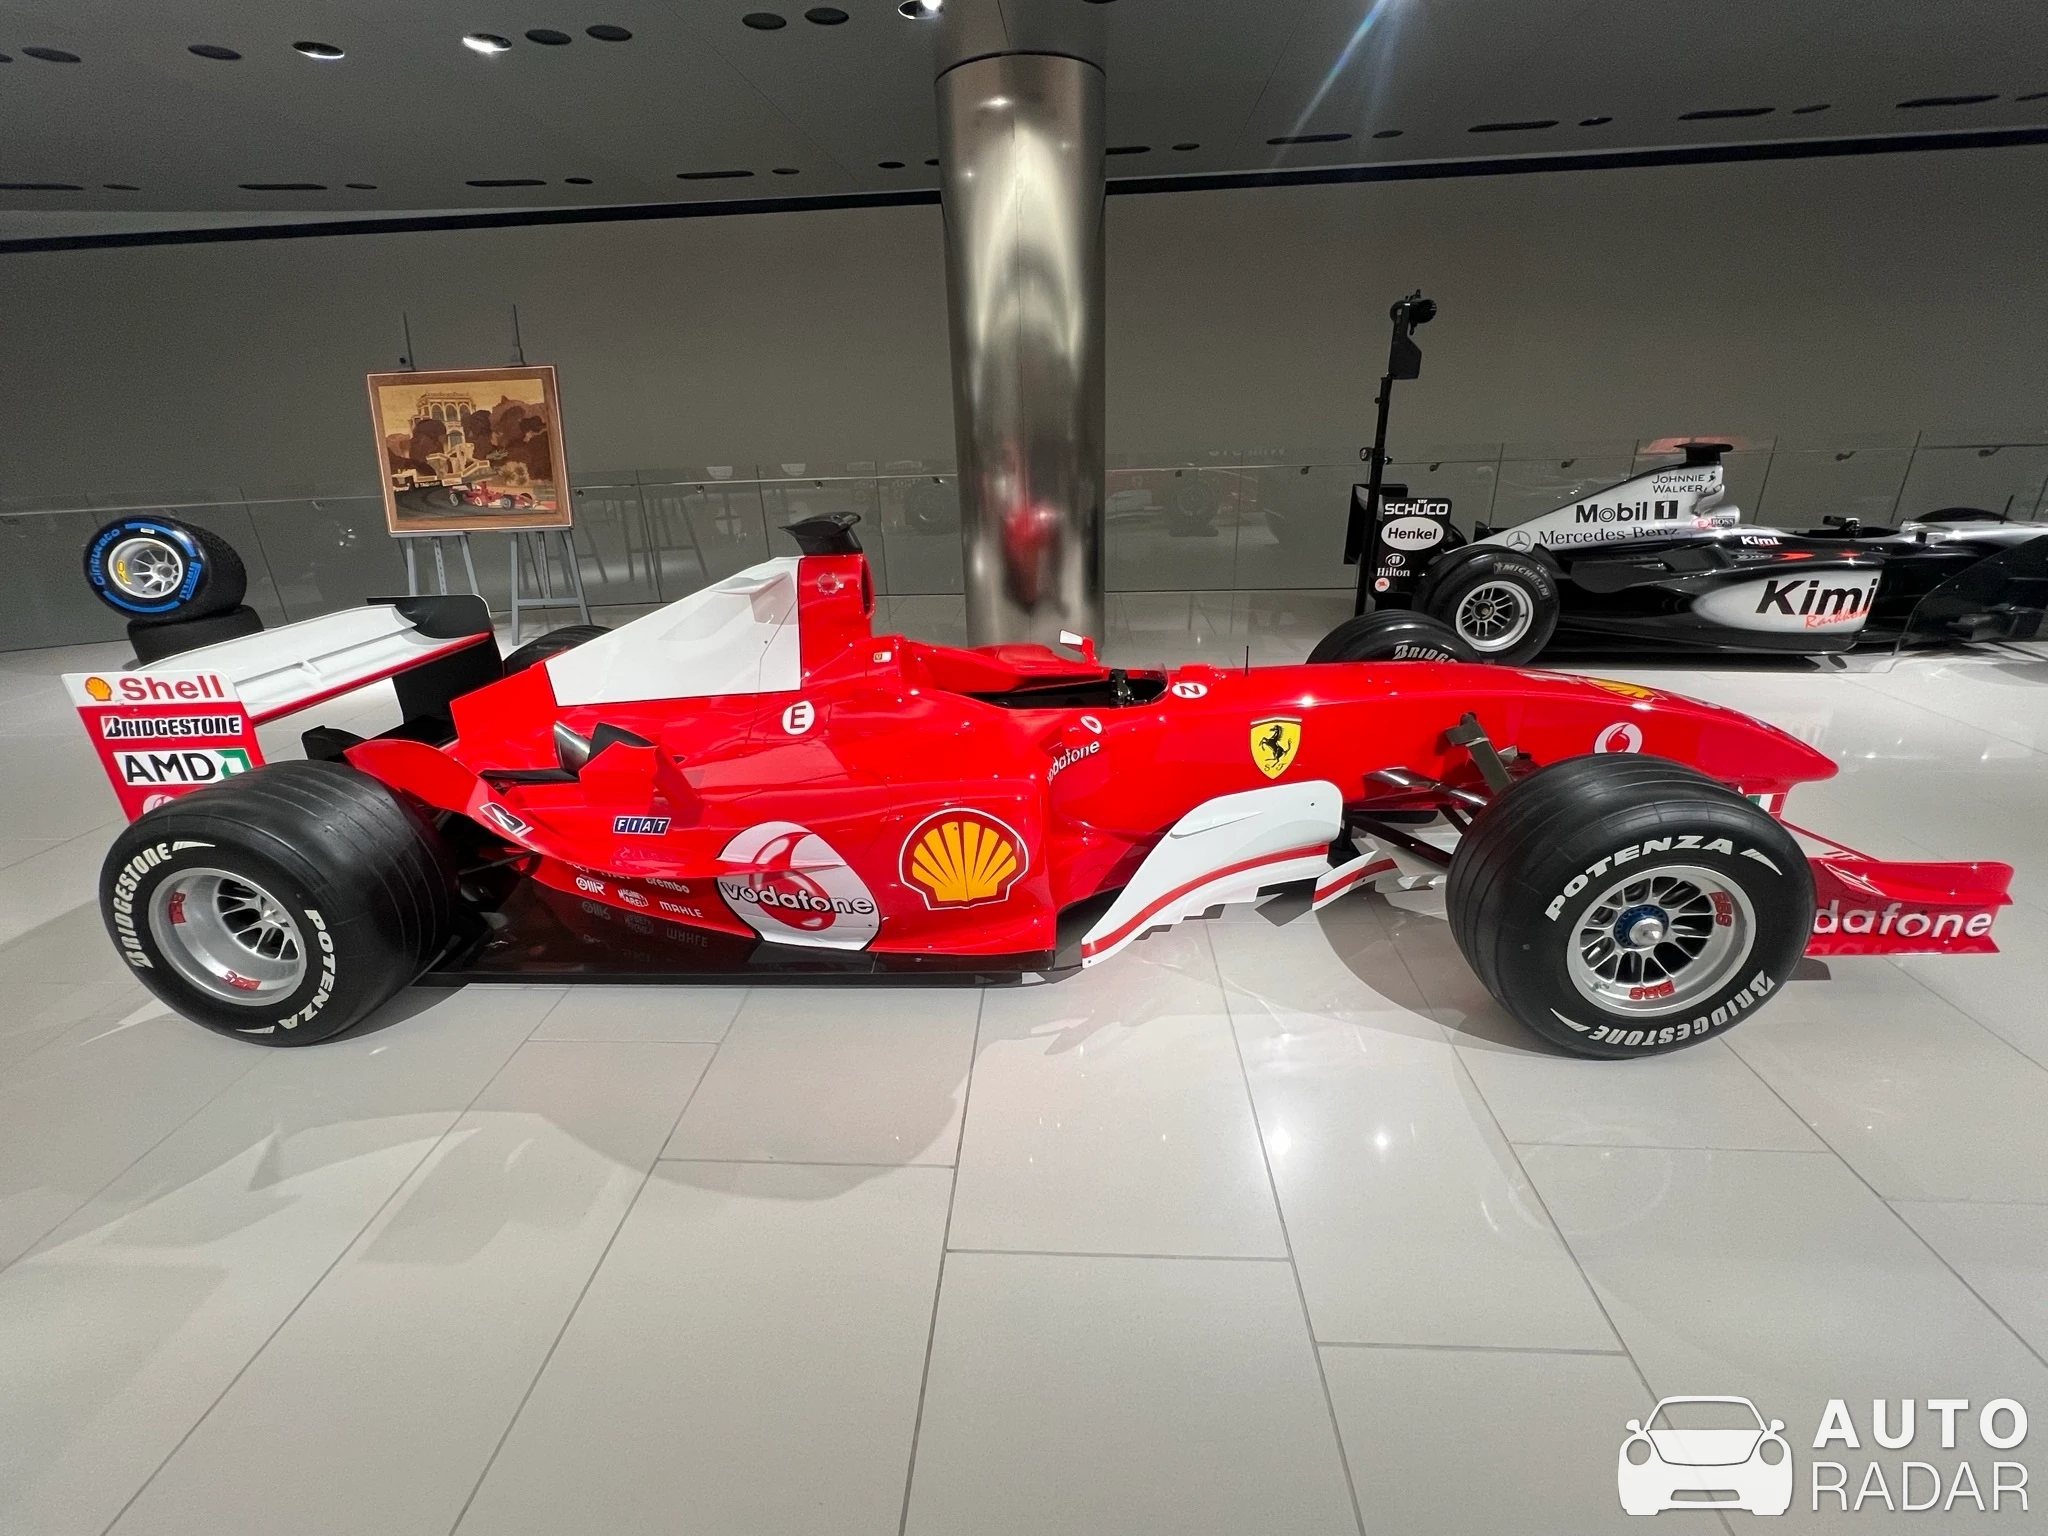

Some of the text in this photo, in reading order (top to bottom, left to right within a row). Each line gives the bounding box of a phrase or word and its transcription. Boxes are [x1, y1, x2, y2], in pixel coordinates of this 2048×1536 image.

[1652, 474, 1706, 484] JOHNNIE
[1653, 485, 1703, 494] WALKER
[1575, 502, 1648, 523] Mobil
[1712, 518, 1734, 526] BOSS
[1388, 527, 1438, 540] Henkel
[1539, 527, 1680, 546] Mercedes-Benz
[1376, 567, 1411, 577] Hilton
[1502, 562, 1551, 598] MICHELIN
[1755, 578, 1879, 616] Kimi
[118, 675, 225, 700] Shell
[104, 716, 240, 738] BRIDGESTONE
[789, 705, 807, 729] E
[125, 753, 216, 783] AMD
[616, 818, 667, 832] FIAT
[1545, 835, 1734, 922] POTENZA
[113, 843, 173, 968] BRIDGESTONE
[659, 901, 704, 918] MAHLE
[720, 881, 875, 914] vodafone
[1813, 900, 1992, 938] dafone
[278, 909, 337, 1030] POTENZA
[1588, 969, 1776, 1046] BRIDGESTONE
